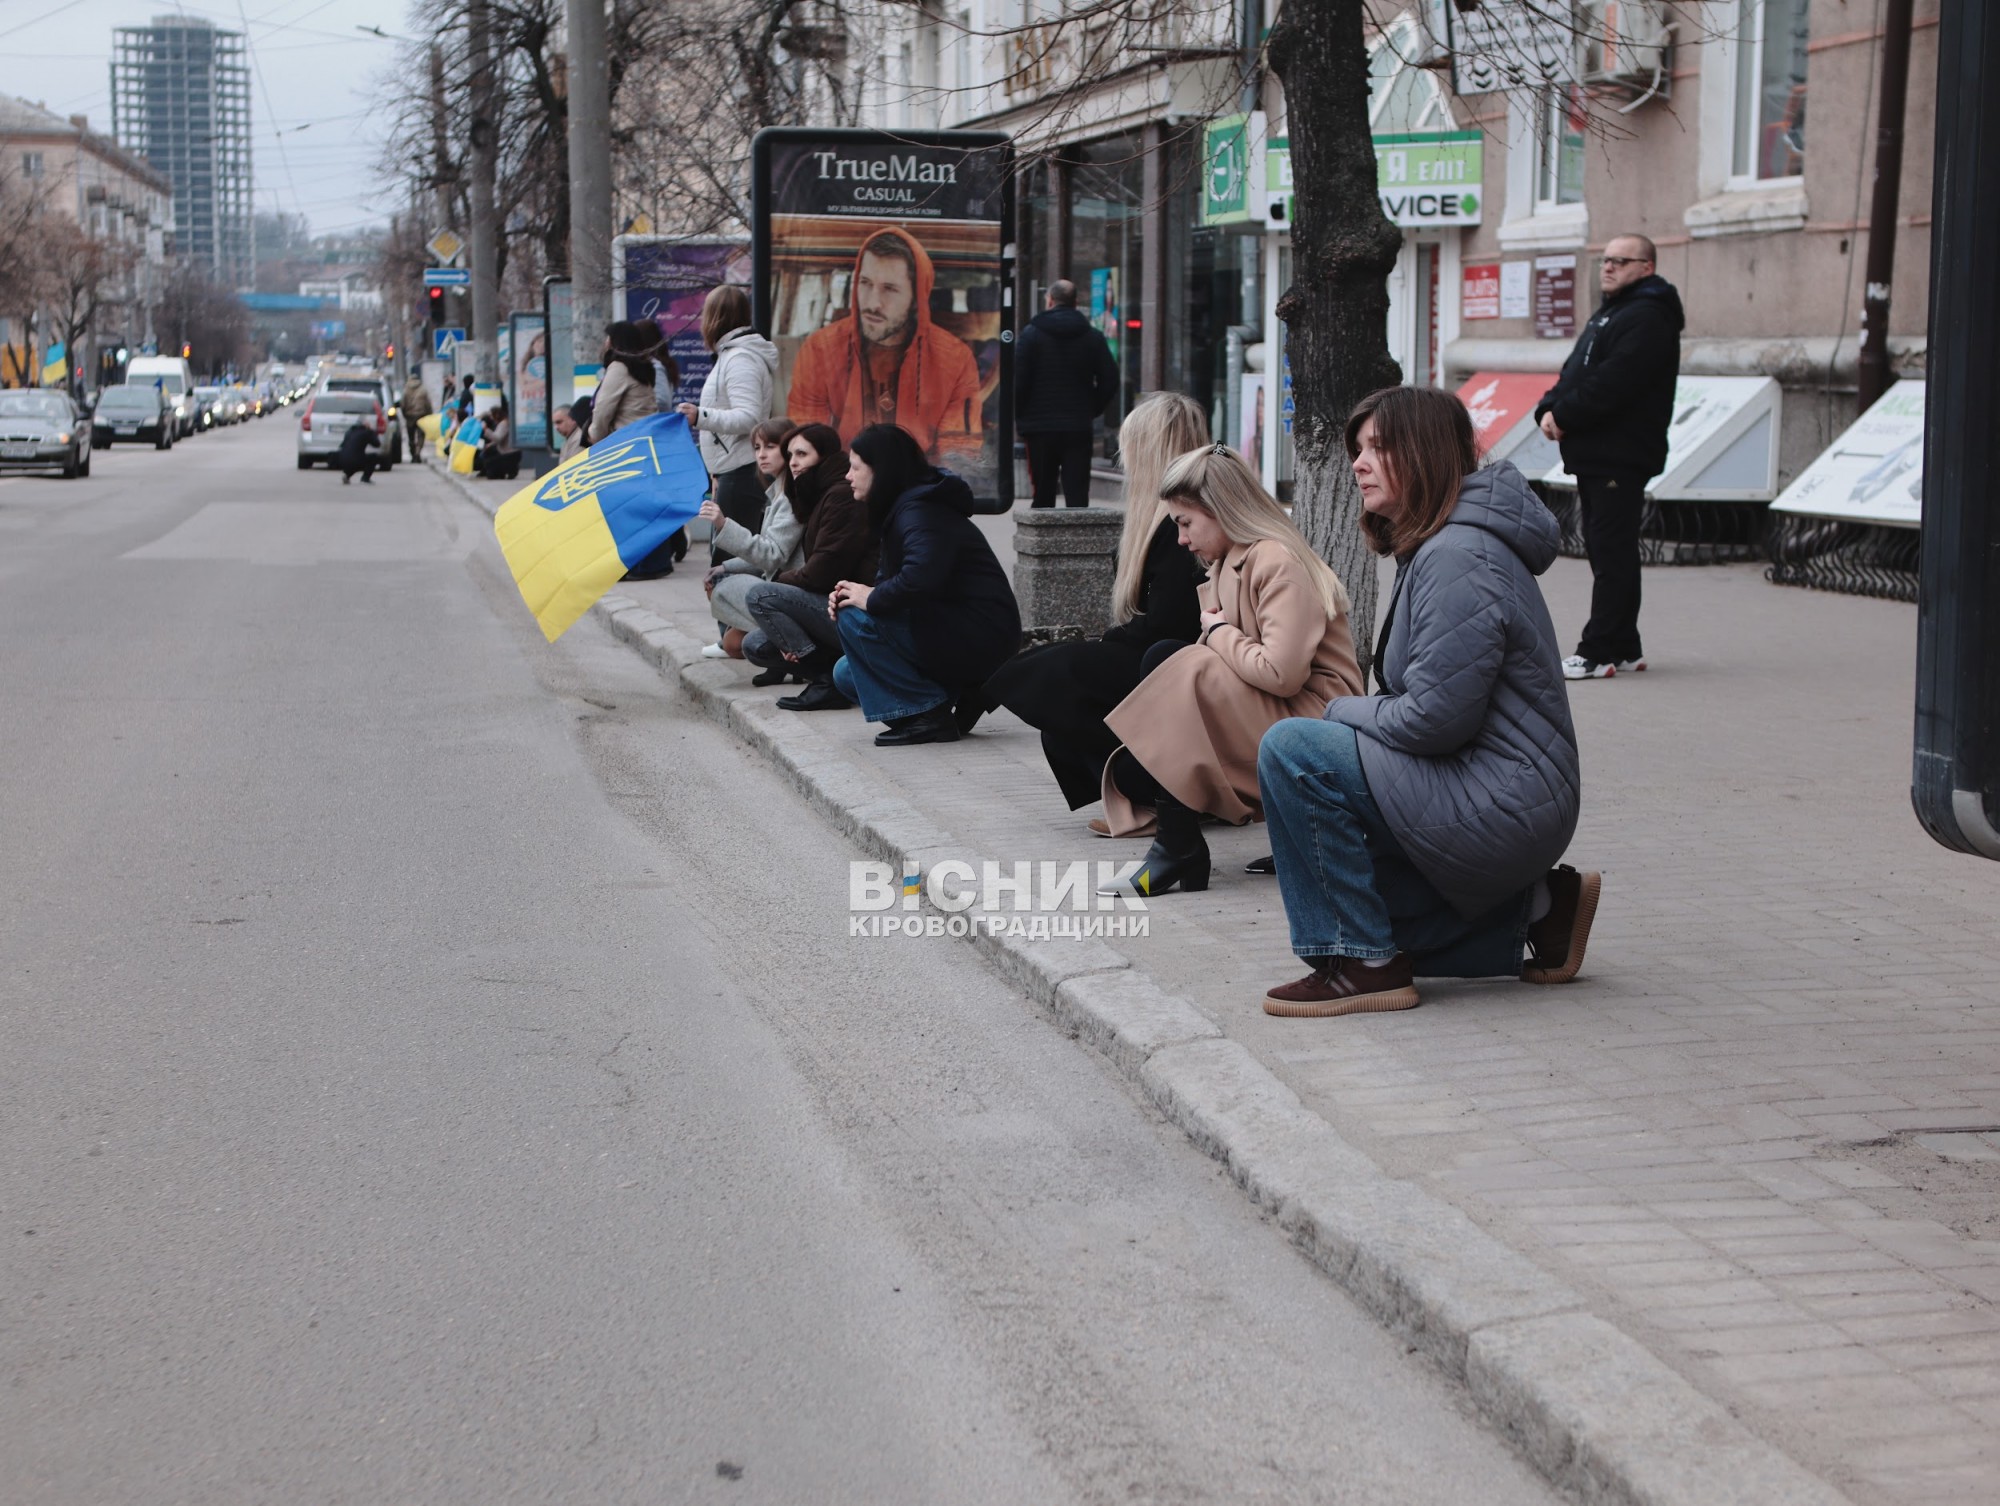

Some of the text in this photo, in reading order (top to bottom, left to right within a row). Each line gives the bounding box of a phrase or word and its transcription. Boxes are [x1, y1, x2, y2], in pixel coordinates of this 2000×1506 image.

[813, 151, 956, 184] TrueMan
[853, 187, 916, 202] CASUAL
[1379, 194, 1458, 217] VICE
